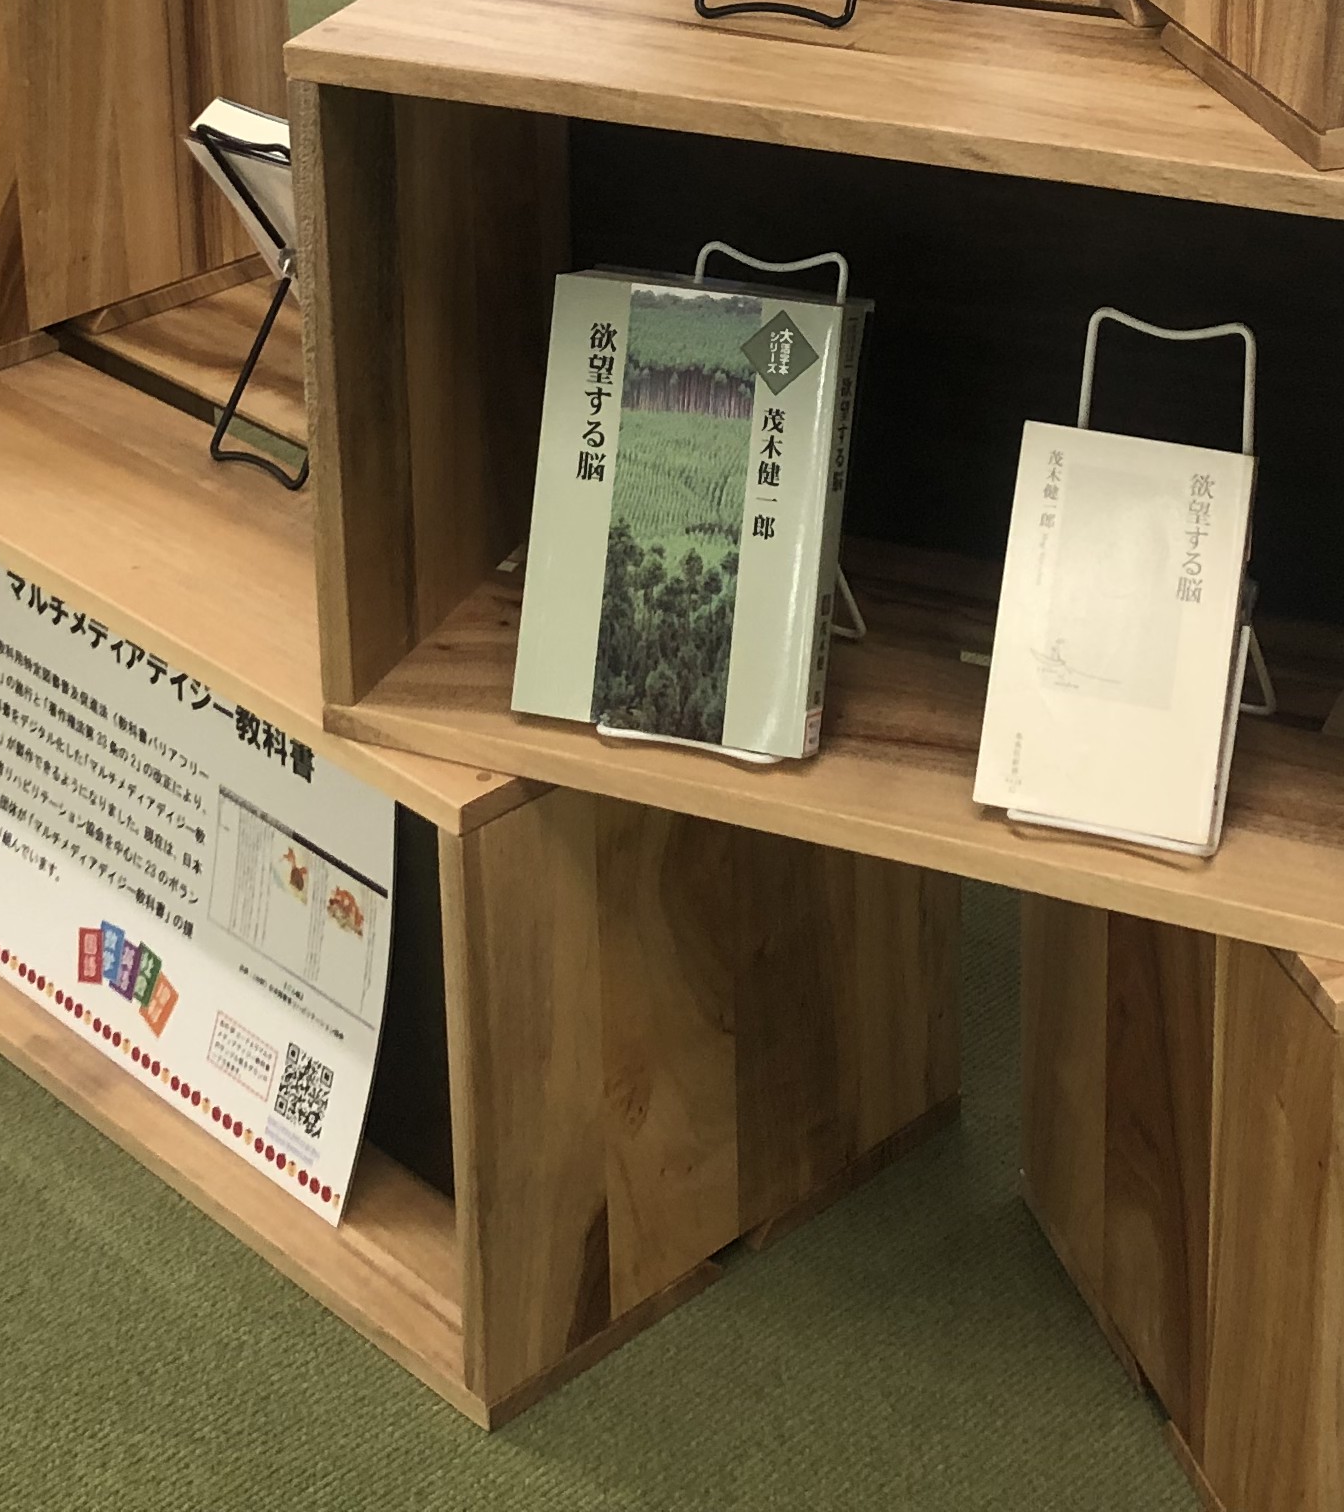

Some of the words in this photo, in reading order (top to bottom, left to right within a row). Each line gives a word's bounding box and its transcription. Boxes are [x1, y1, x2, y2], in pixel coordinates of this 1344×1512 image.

[575, 322, 618, 483] 欲望する脳
[766, 331, 781, 375] シリーズ
[778, 328, 795, 377] 大活字本
[752, 407, 787, 541] 茂木健一郎
[1039, 448, 1064, 529] 茂木健一郎
[1175, 472, 1216, 605] 欲望する脳
